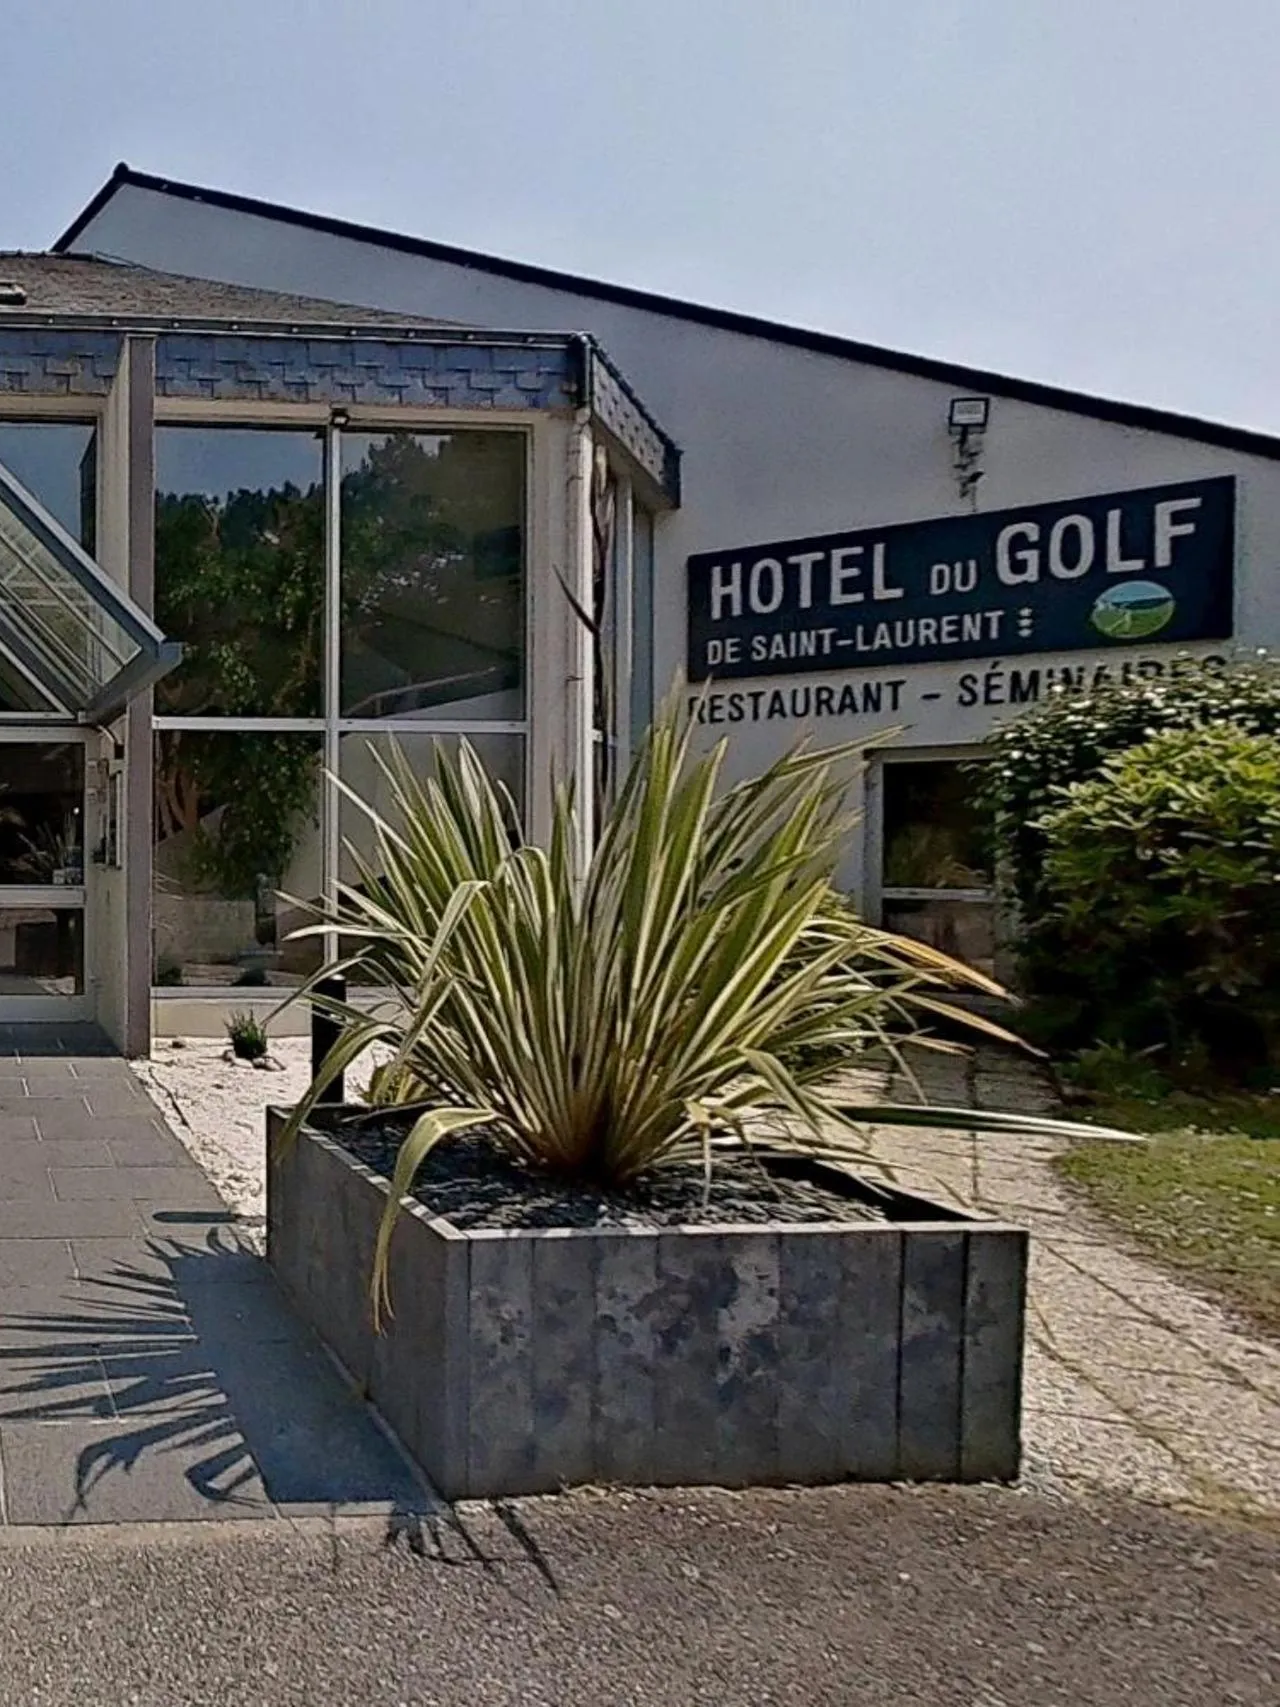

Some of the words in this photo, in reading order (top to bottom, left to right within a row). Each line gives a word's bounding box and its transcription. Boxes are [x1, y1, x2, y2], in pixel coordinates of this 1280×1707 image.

[711, 543, 904, 619] HOTEL
[931, 560, 976, 594] DU
[996, 498, 1202, 585] GOLF
[708, 638, 741, 664] DE
[752, 611, 1004, 661] SAINT-LAURENT
[689, 680, 906, 724] RESTAURANT
